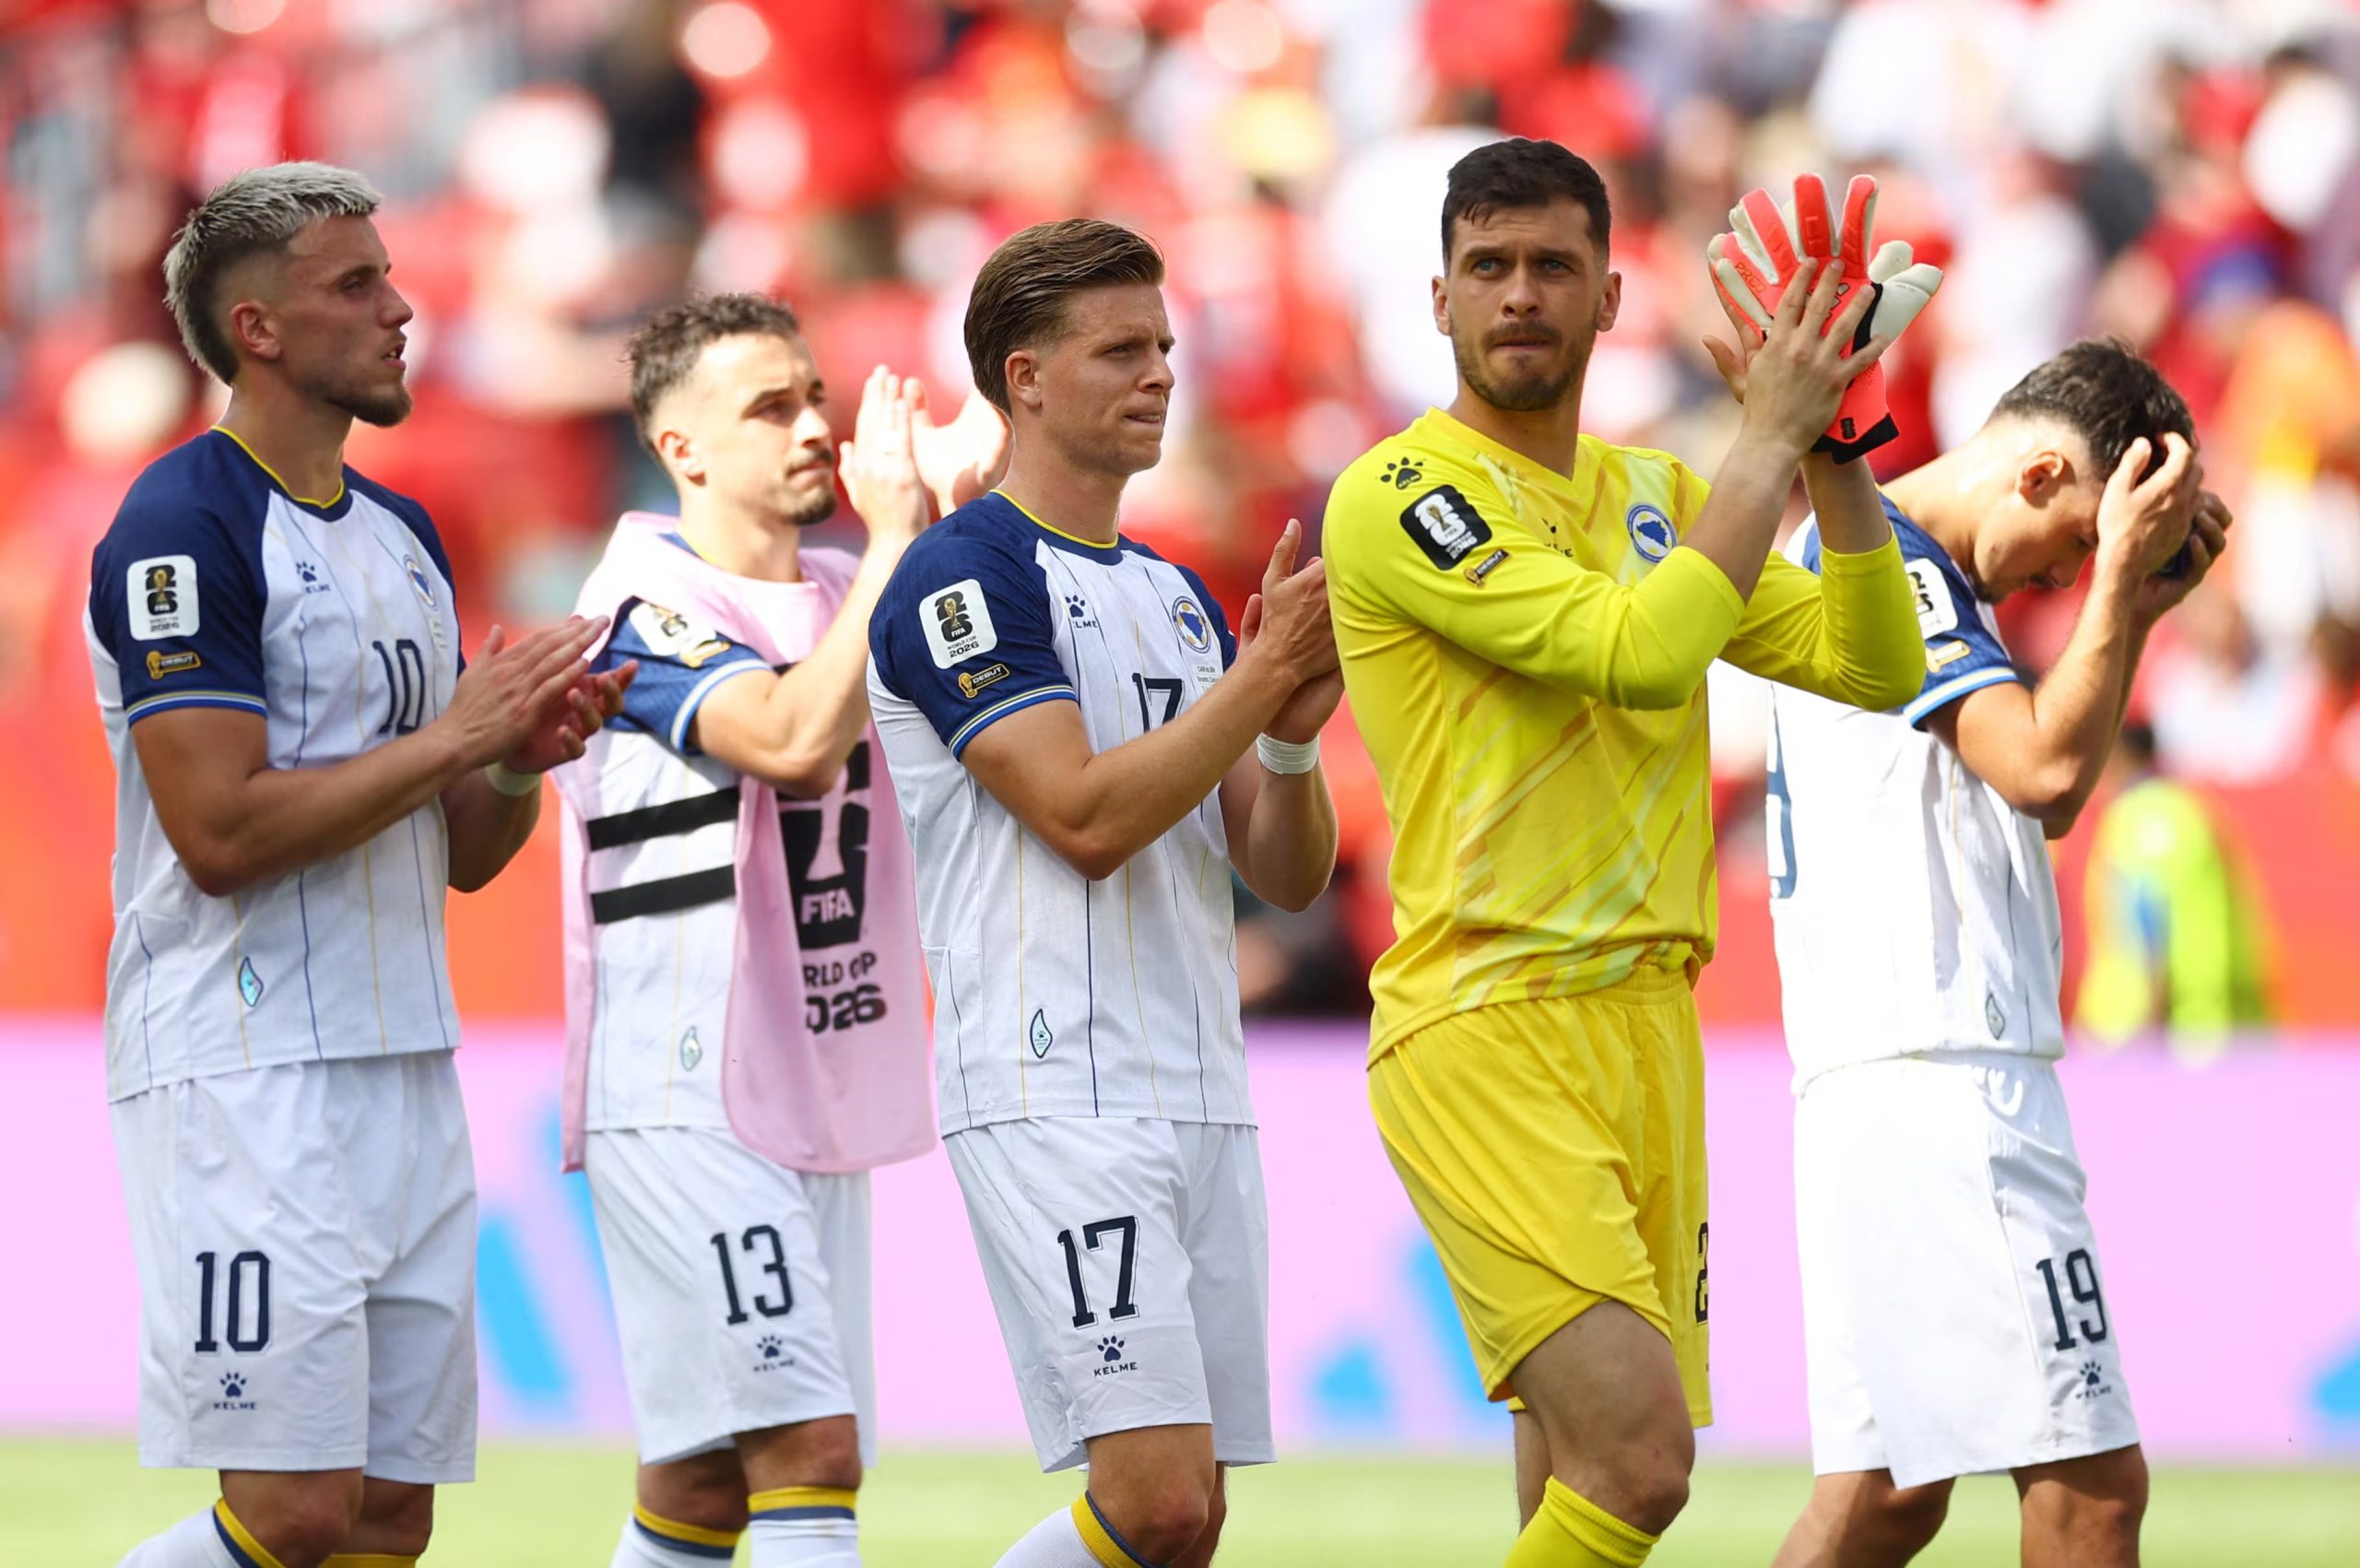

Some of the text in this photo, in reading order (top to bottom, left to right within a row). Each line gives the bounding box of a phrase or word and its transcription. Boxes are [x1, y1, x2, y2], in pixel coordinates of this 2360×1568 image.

[947, 635, 977, 651] WORLD CUP
[949, 641, 980, 658] 2026
[951, 627, 966, 638] FIFA
[372, 639, 426, 736] 10
[972, 666, 1002, 684] DEBUT
[1132, 672, 1184, 735] 17
[800, 887, 856, 925] FIFA
[802, 961, 845, 988] RLD
[805, 983, 888, 1035] 026
[710, 1223, 795, 1326] 13
[1056, 1215, 1139, 1329] 17
[195, 1250, 272, 1355] 10
[2035, 1248, 2107, 1351] 19
[1093, 1362, 1138, 1377] KELME
[213, 1401, 257, 1410] KELME
